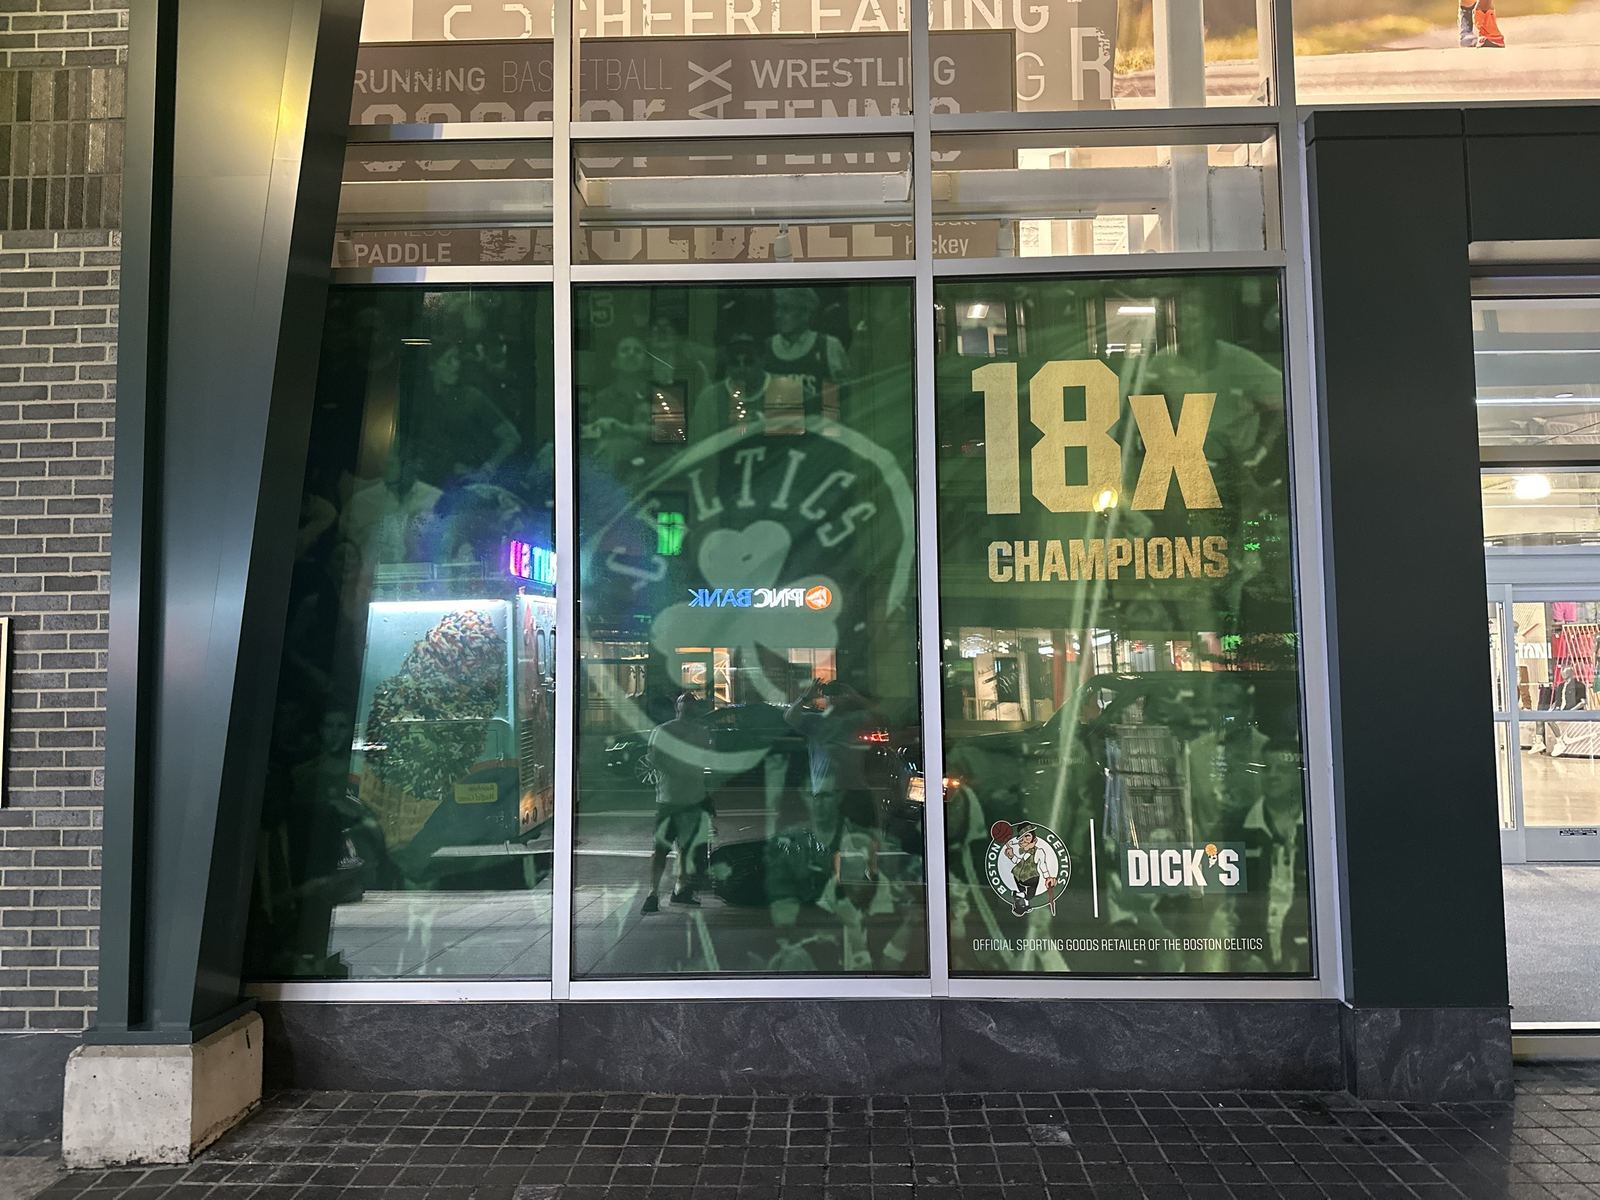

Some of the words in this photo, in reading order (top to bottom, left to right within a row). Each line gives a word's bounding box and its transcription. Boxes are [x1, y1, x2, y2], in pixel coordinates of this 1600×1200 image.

[354, 66, 487, 94] RUNNING
[502, 58, 672, 93] BASETBALL
[751, 56, 956, 89] WRESTLIG
[355, 243, 451, 265] PADDLE
[905, 235, 969, 257] hckey
[988, 535, 1229, 583] CHAMPIONS
[987, 842, 1008, 895] BOSTON
[1046, 833, 1069, 886] CELTICS
[1127, 843, 1240, 887] DICK'S
[973, 938, 1014, 951] OFFICIAL
[1016, 938, 1064, 951] SPORTING
[1065, 938, 1099, 951] GOODS
[1101, 938, 1146, 951] RETAILER
[1148, 938, 1160, 951] OF
[1162, 938, 1181, 951] THE
[1183, 937, 1222, 951] BOSTON
[1223, 937, 1263, 950] CELTICS
